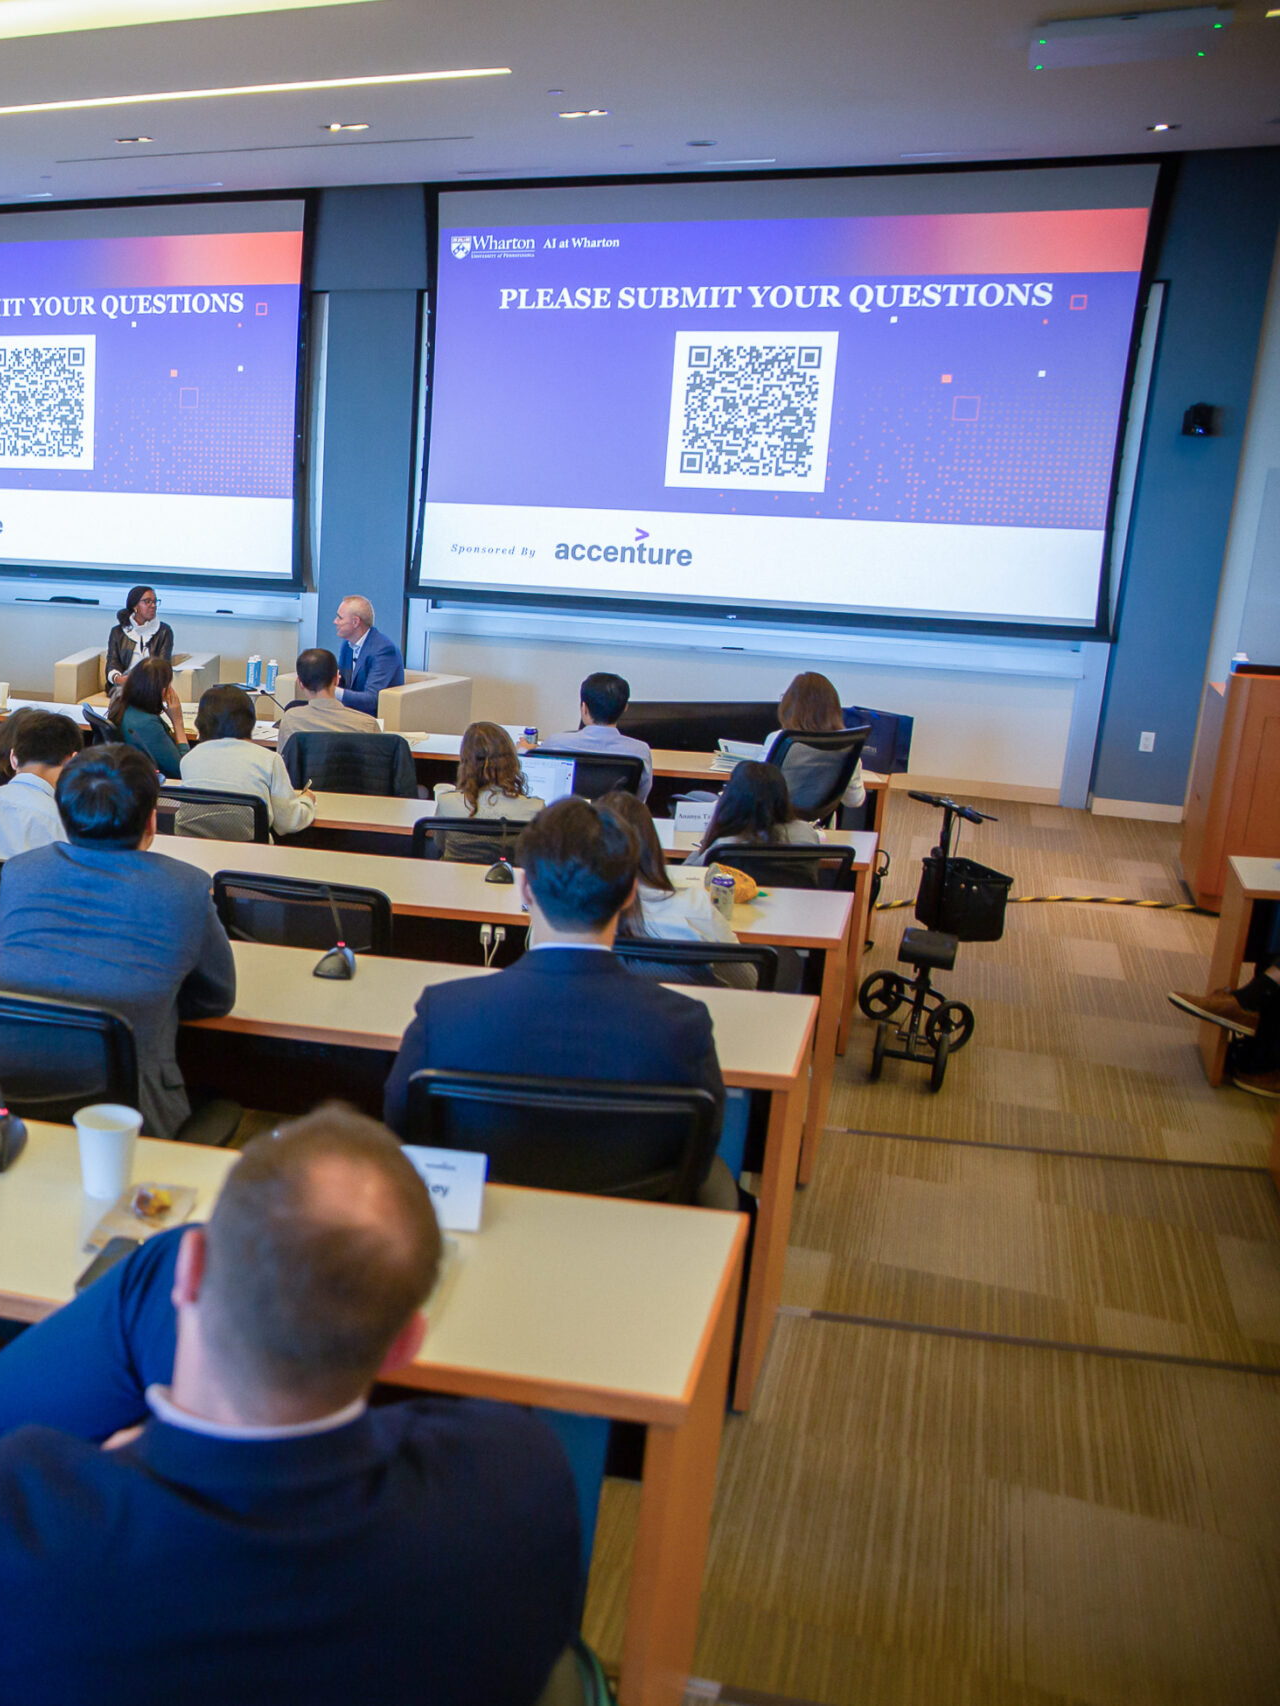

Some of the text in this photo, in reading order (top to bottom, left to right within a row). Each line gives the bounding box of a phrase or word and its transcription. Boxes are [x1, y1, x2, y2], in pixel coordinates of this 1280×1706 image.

[472, 235, 535, 250] Wharton
[543, 237, 620, 249] AI at Wharton
[29, 296, 97, 317] YOUR
[101, 292, 244, 319] QUESTIONS
[499, 282, 1054, 312] PLEASE SUBMIT YOUR QUESTIONS
[450, 543, 536, 558] Sponsored By
[554, 542, 693, 566] accenture
